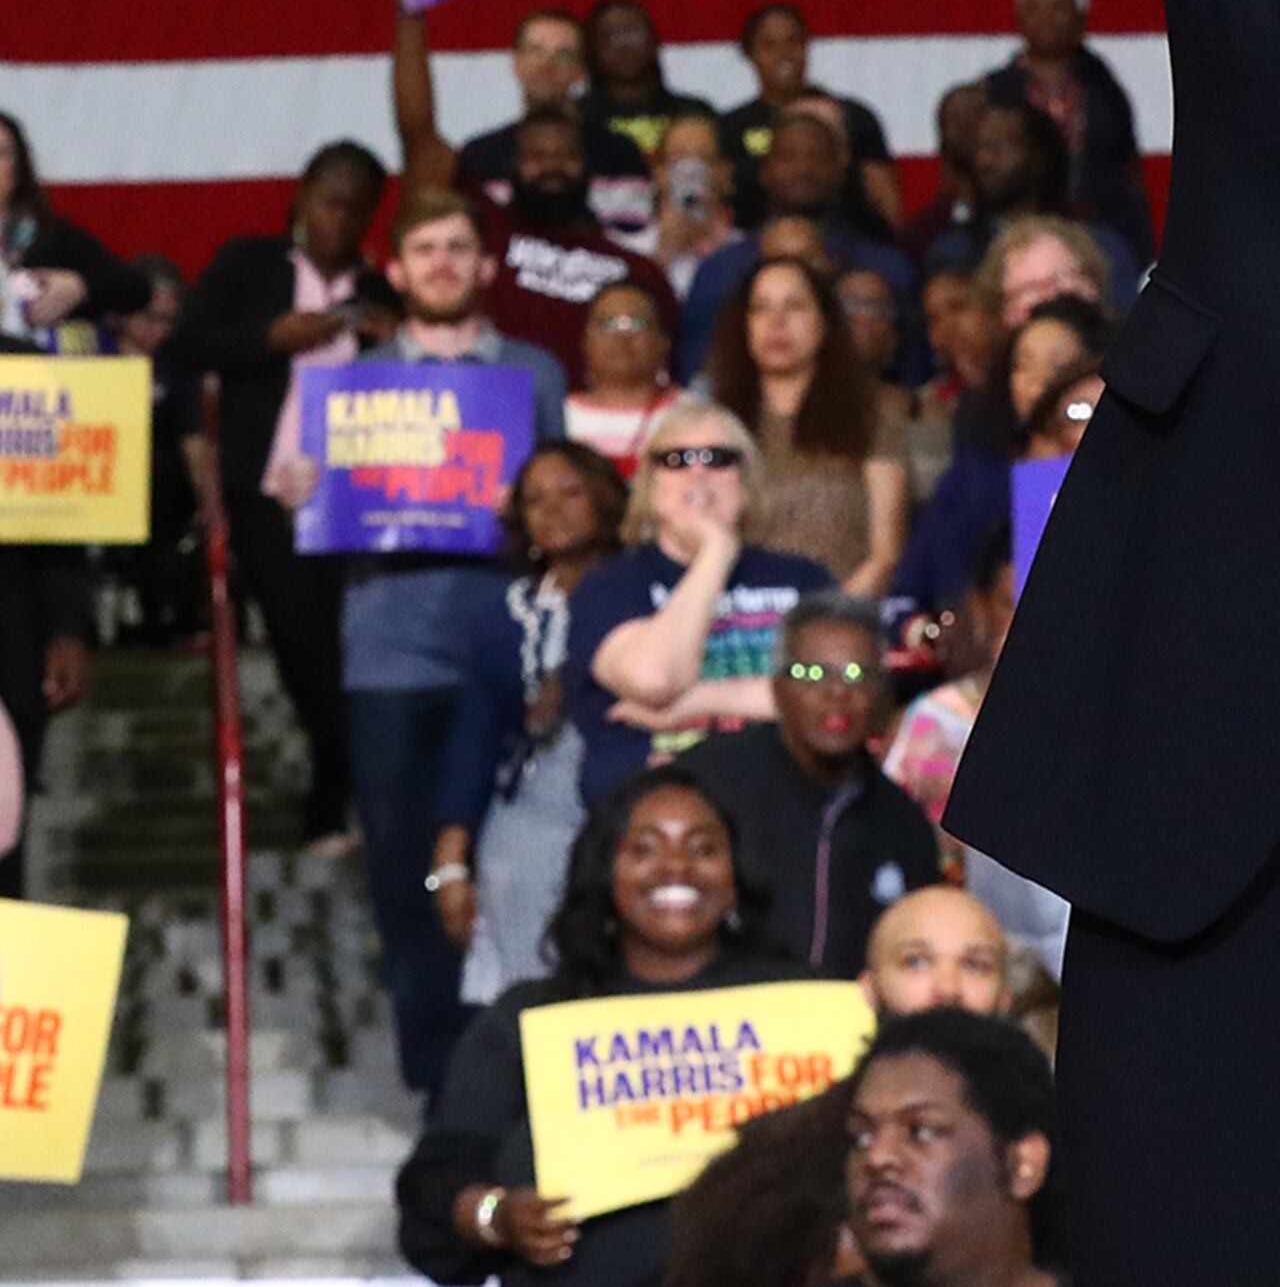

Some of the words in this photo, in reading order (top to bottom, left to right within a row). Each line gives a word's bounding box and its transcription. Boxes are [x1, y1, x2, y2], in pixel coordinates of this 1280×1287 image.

[328, 388, 462, 430] KAMALA
[58, 423, 116, 457] FOR
[328, 430, 447, 469] HARRIS
[445, 429, 505, 467] FOR
[4, 459, 116, 495] PEOPLE
[384, 464, 500, 506] PEOPLE
[575, 1019, 762, 1069] KAMALA
[578, 1062, 746, 1111] HARRIS
[751, 1050, 835, 1090] FOR
